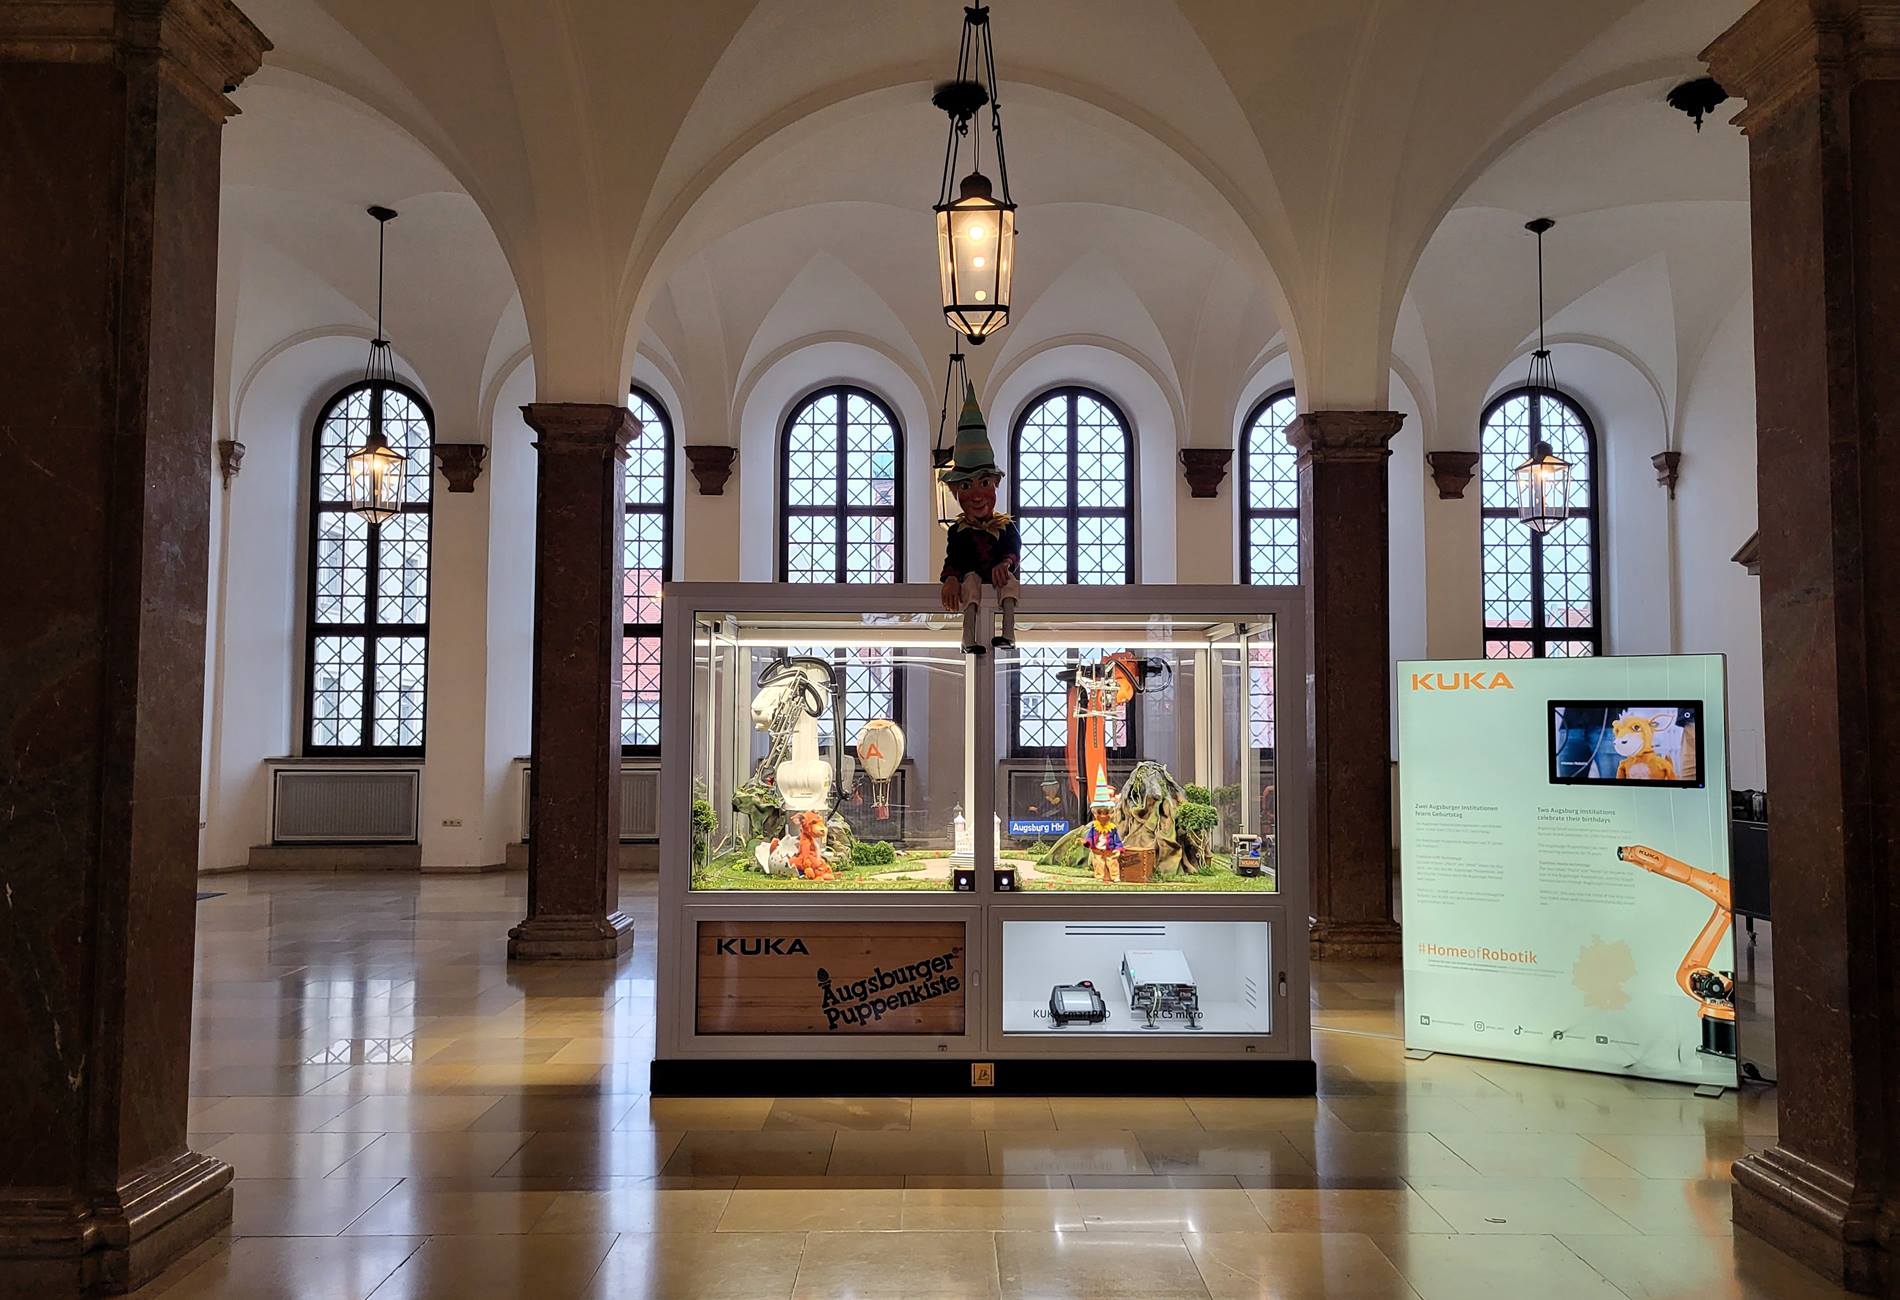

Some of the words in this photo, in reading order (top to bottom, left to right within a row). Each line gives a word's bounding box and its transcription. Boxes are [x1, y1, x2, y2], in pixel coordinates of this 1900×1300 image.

[1412, 672, 1515, 691] KUKA
[1432, 811, 1463, 819] Geburtstag
[1550, 807, 1579, 815] Augsburg
[1581, 816, 1611, 824] birthdays
[1013, 823, 1049, 833] Augsburg
[716, 938, 810, 955] KUKA
[1418, 943, 1537, 964] #HomeofRobotik
[821, 951, 961, 1008] Augsburger
[823, 974, 961, 1030] Puppenkiste
[1146, 1009, 1158, 1018] KR
[1176, 1009, 1204, 1019] micro
